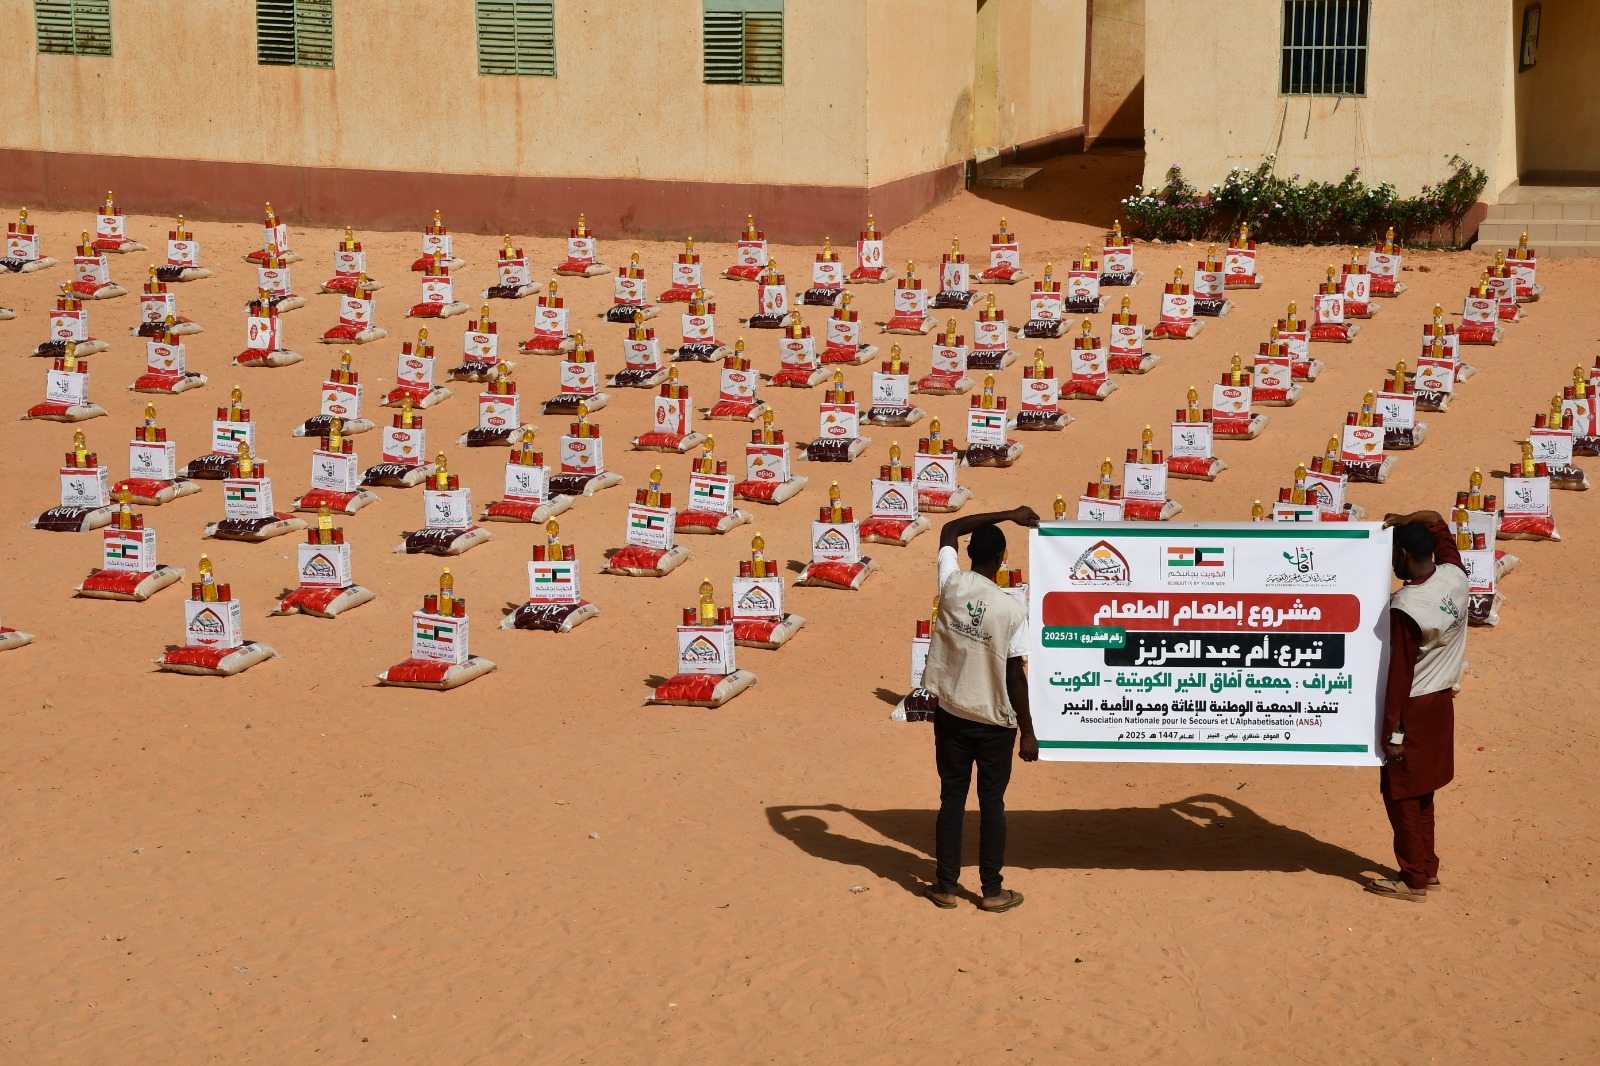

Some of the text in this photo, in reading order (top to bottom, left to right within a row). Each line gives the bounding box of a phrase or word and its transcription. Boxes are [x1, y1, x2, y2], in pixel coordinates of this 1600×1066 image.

[873, 407, 909, 416] Aloha
[48, 506, 87, 518] Aloha
[1167, 570, 1226, 579] الكويت بجانبكم
[1093, 598, 1321, 627] مشروع إطعام الطعام
[1044, 632, 1078, 641] 2025/31
[1109, 632, 1123, 643] رقم
[1135, 634, 1323, 667] تبرع: أم عبد العزيز
[1049, 670, 1352, 695] إشراف جمعية آفاق الخير الكويتية الكويت
[1061, 695, 1339, 718] تنفيذ: الجمعية الوطنية للإغاثة ومحو الأمية النيجر
[1080, 716, 1123, 724] Association
[1125, 716, 1160, 724] Nationale
[1162, 718, 1178, 726] pour
[1189, 717, 1219, 725] Secours
[1296, 718, 1323, 727] (ANSA)
